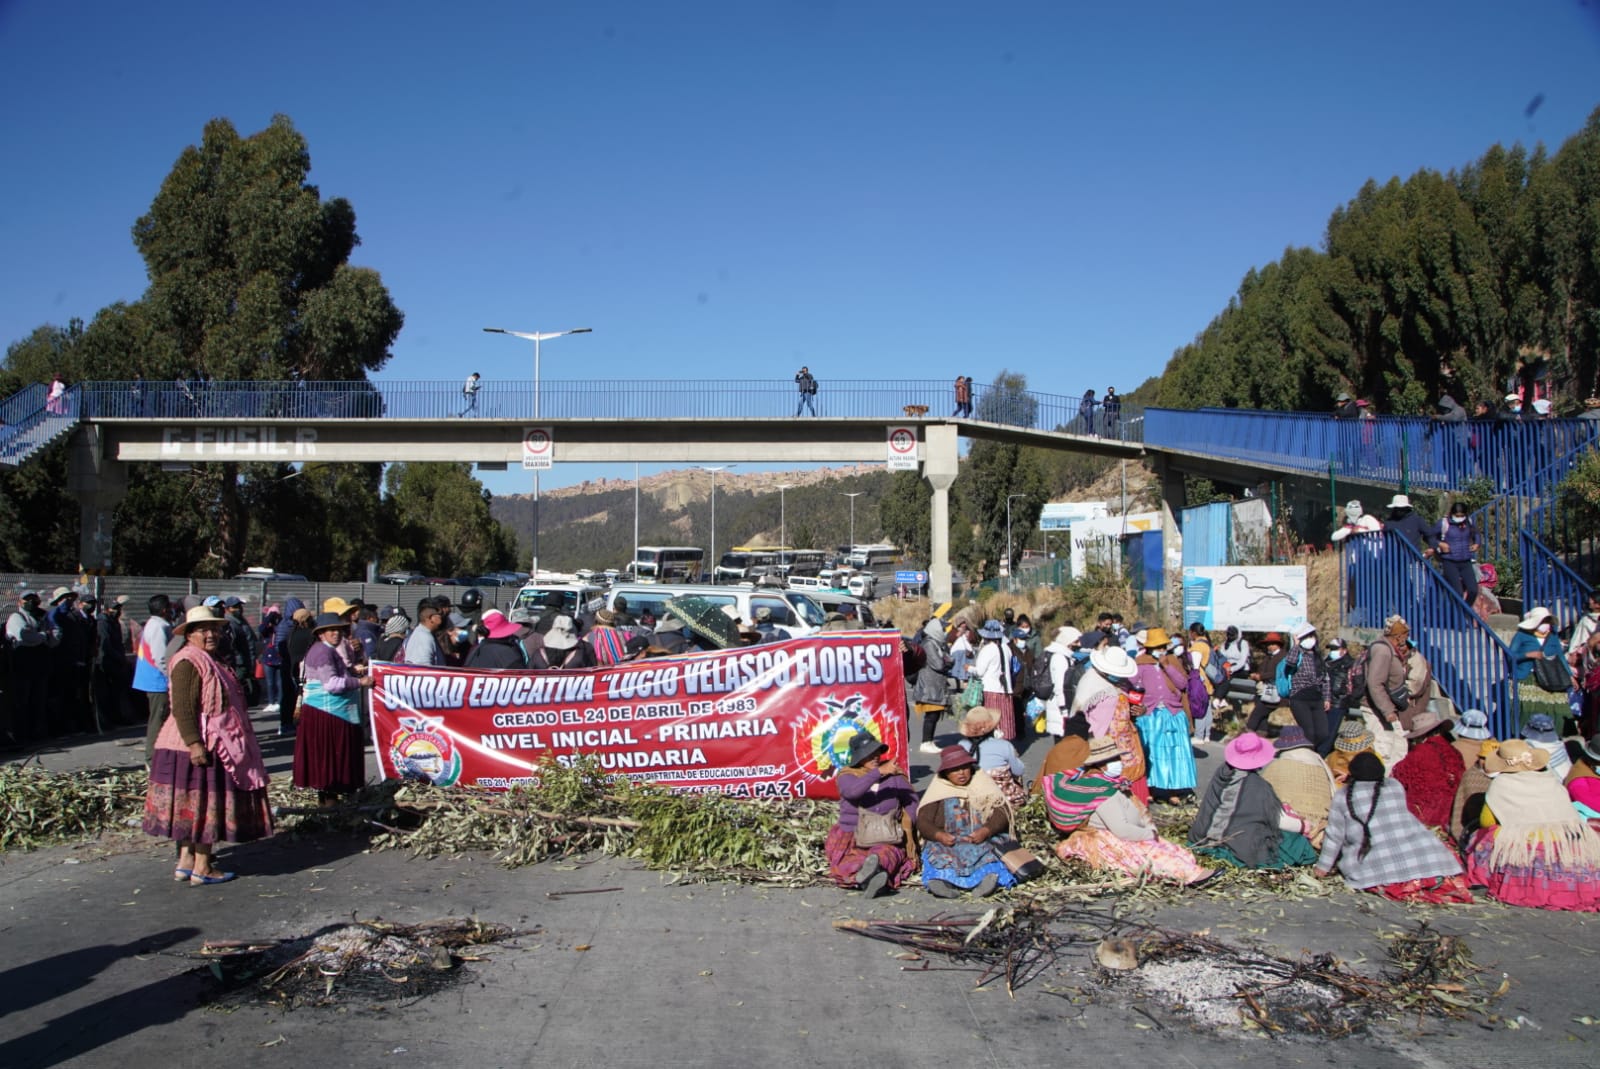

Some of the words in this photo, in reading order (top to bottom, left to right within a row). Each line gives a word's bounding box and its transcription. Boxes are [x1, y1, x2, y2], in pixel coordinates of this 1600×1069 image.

[383, 674, 467, 710] UNIDAD
[469, 674, 595, 708] EDUCATIVA
[683, 650, 793, 695] VELASCO
[493, 712, 557, 728] CREADO
[562, 710, 581, 723] EL
[586, 709, 605, 722] 24
[610, 707, 631, 720] DE
[636, 704, 685, 719] ABRIL
[690, 702, 711, 715] DE
[718, 699, 755, 713] 1983
[480, 733, 546, 750] NIVEL
[552, 728, 638, 748] INICIAL
[659, 718, 778, 742] PRIMARIA
[478, 778, 493, 787] RED
[687, 770, 697, 778] DE
[700, 767, 745, 779] EDUCACION
[747, 767, 757, 776] LA
[759, 766, 774, 775] PAZ
[726, 783, 749, 796] LA
[755, 782, 790, 796] PAZ
[796, 781, 804, 796] 1
